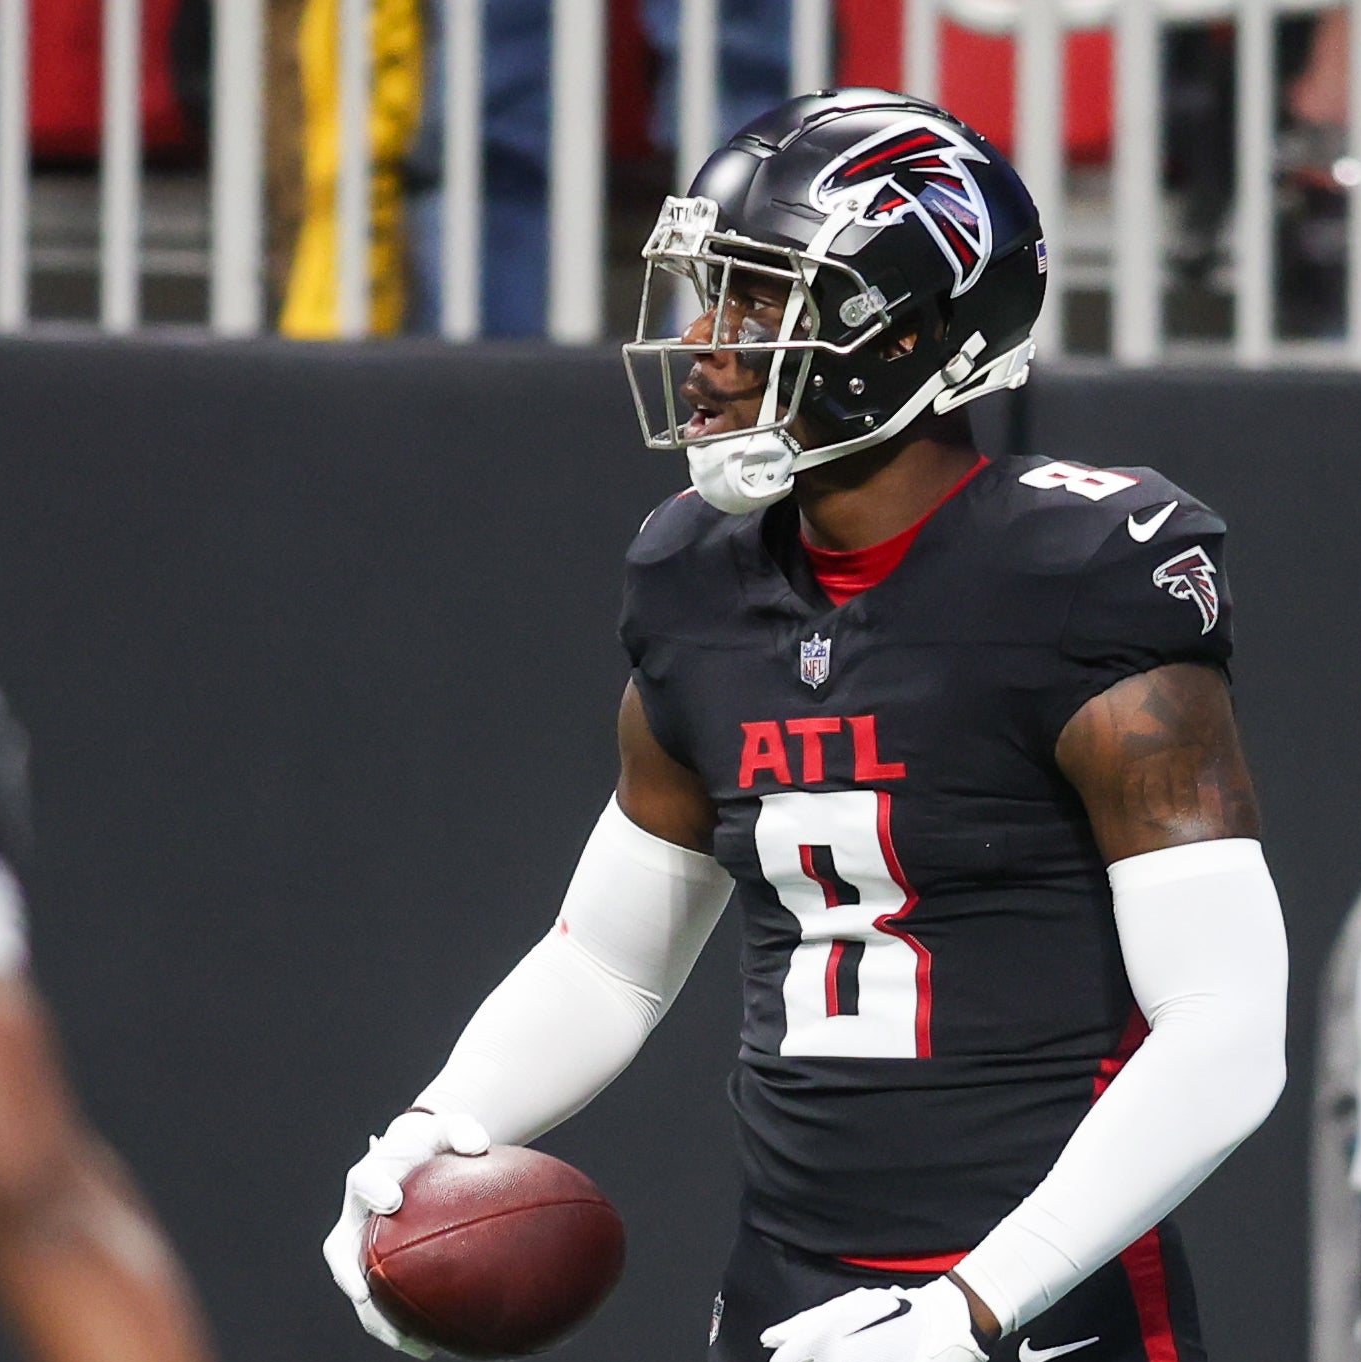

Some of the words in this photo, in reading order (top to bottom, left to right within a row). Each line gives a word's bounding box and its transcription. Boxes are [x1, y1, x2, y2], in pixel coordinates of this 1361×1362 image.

[1018, 460, 1142, 502] 8
[804, 658, 825, 681] NFL
[738, 714, 907, 788] ATL
[755, 790, 932, 1058] 8
